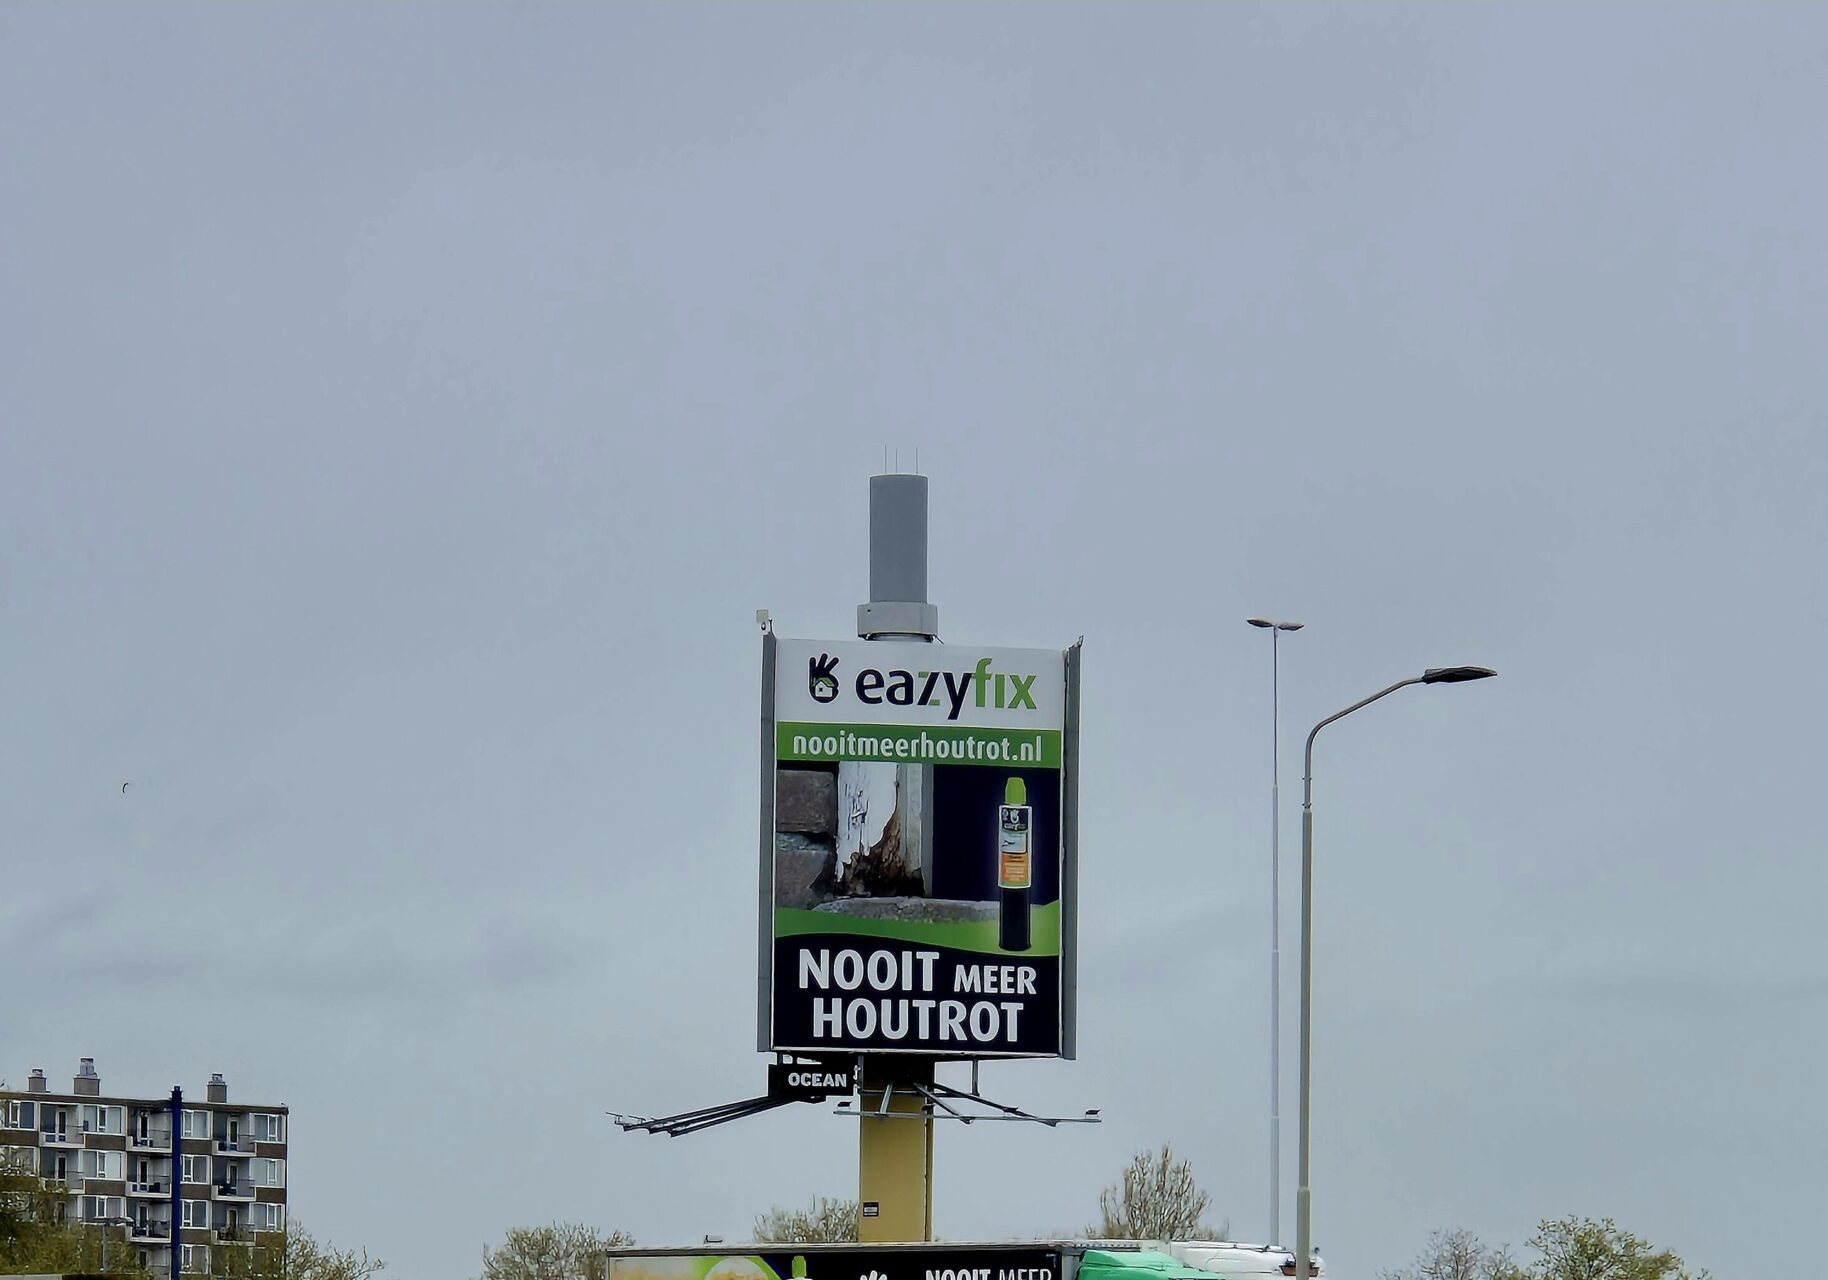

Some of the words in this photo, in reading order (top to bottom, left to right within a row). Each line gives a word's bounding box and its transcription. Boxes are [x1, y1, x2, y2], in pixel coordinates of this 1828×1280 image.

[855, 657, 1037, 720] eazyfix
[793, 730, 1042, 762] nooitmeerhoutrot.nl
[799, 949, 940, 992] NOOIT
[953, 964, 1037, 995] MEER
[813, 997, 1024, 1042] HOUTROT
[788, 1072, 847, 1088] OCEAN
